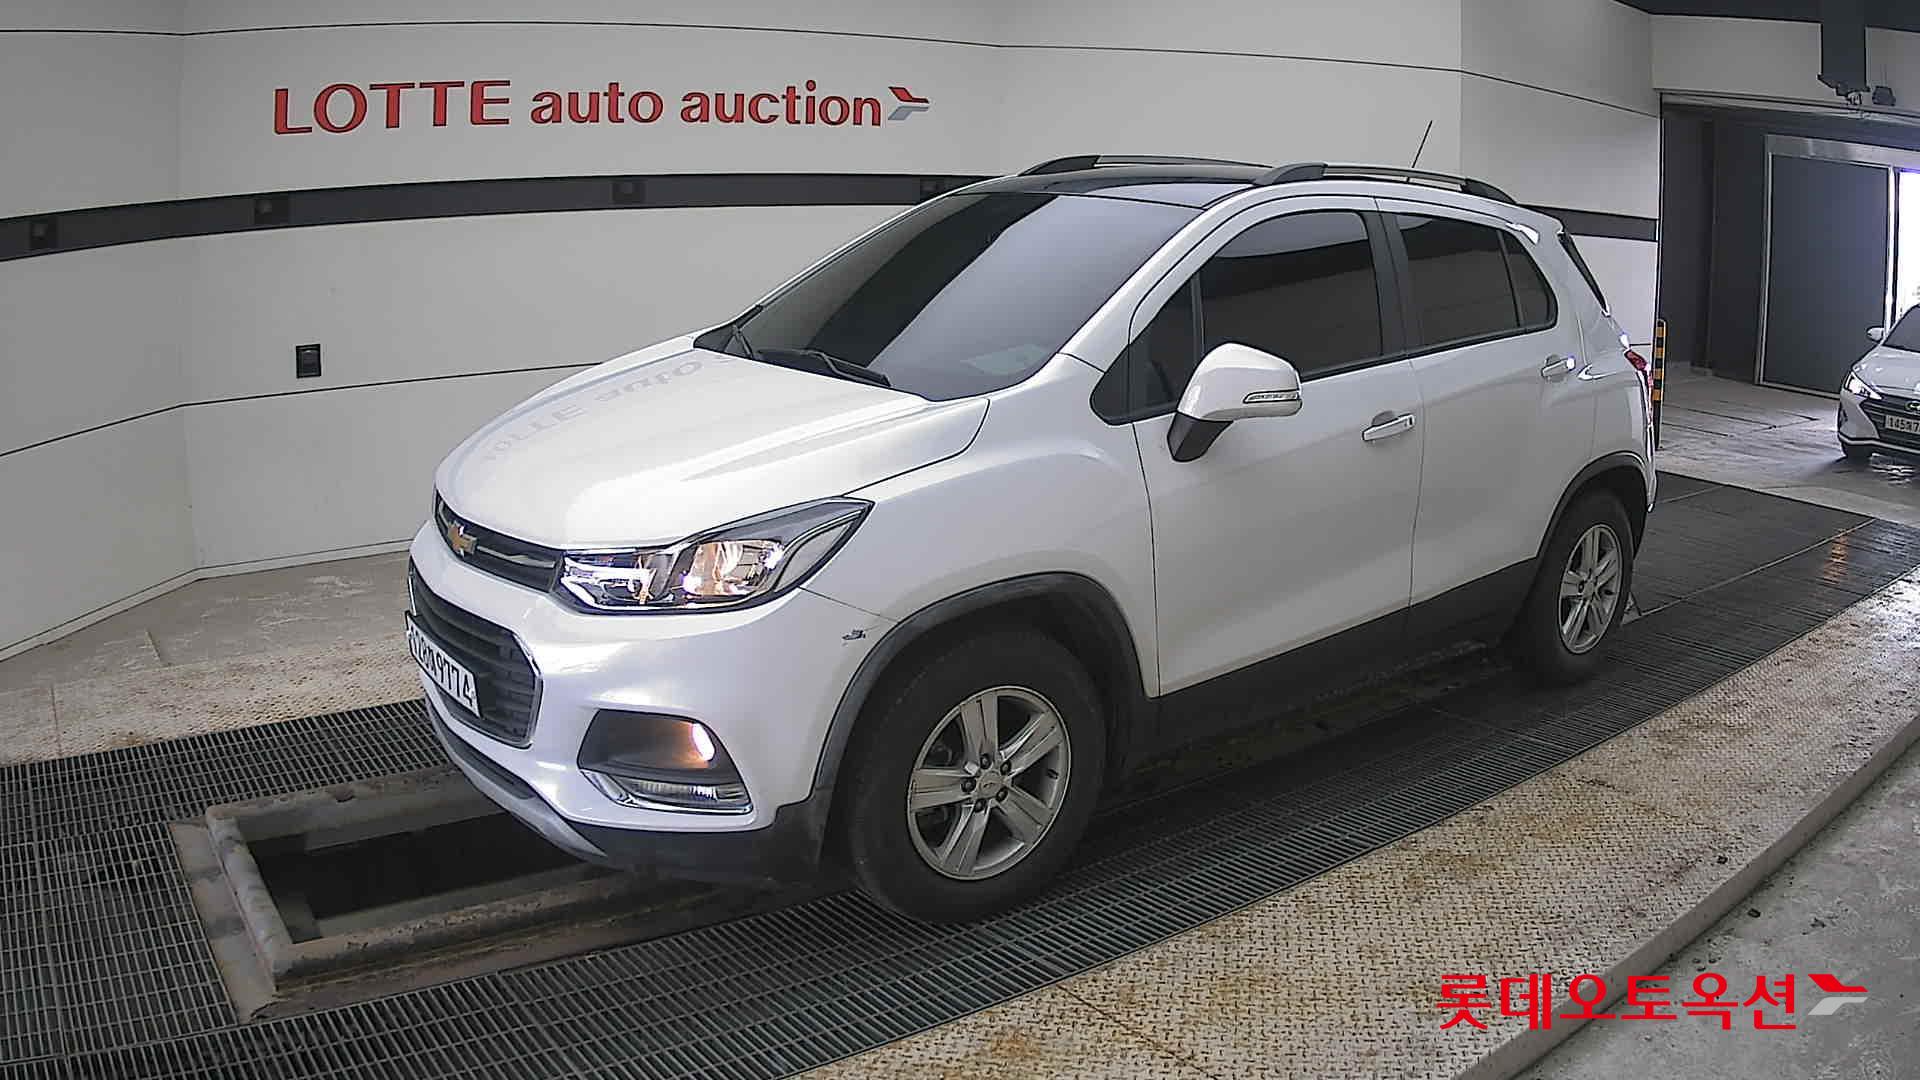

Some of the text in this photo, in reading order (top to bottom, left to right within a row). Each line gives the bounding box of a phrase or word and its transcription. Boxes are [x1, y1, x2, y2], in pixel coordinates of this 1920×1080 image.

[274, 79, 881, 135] LOTTE auto auction
